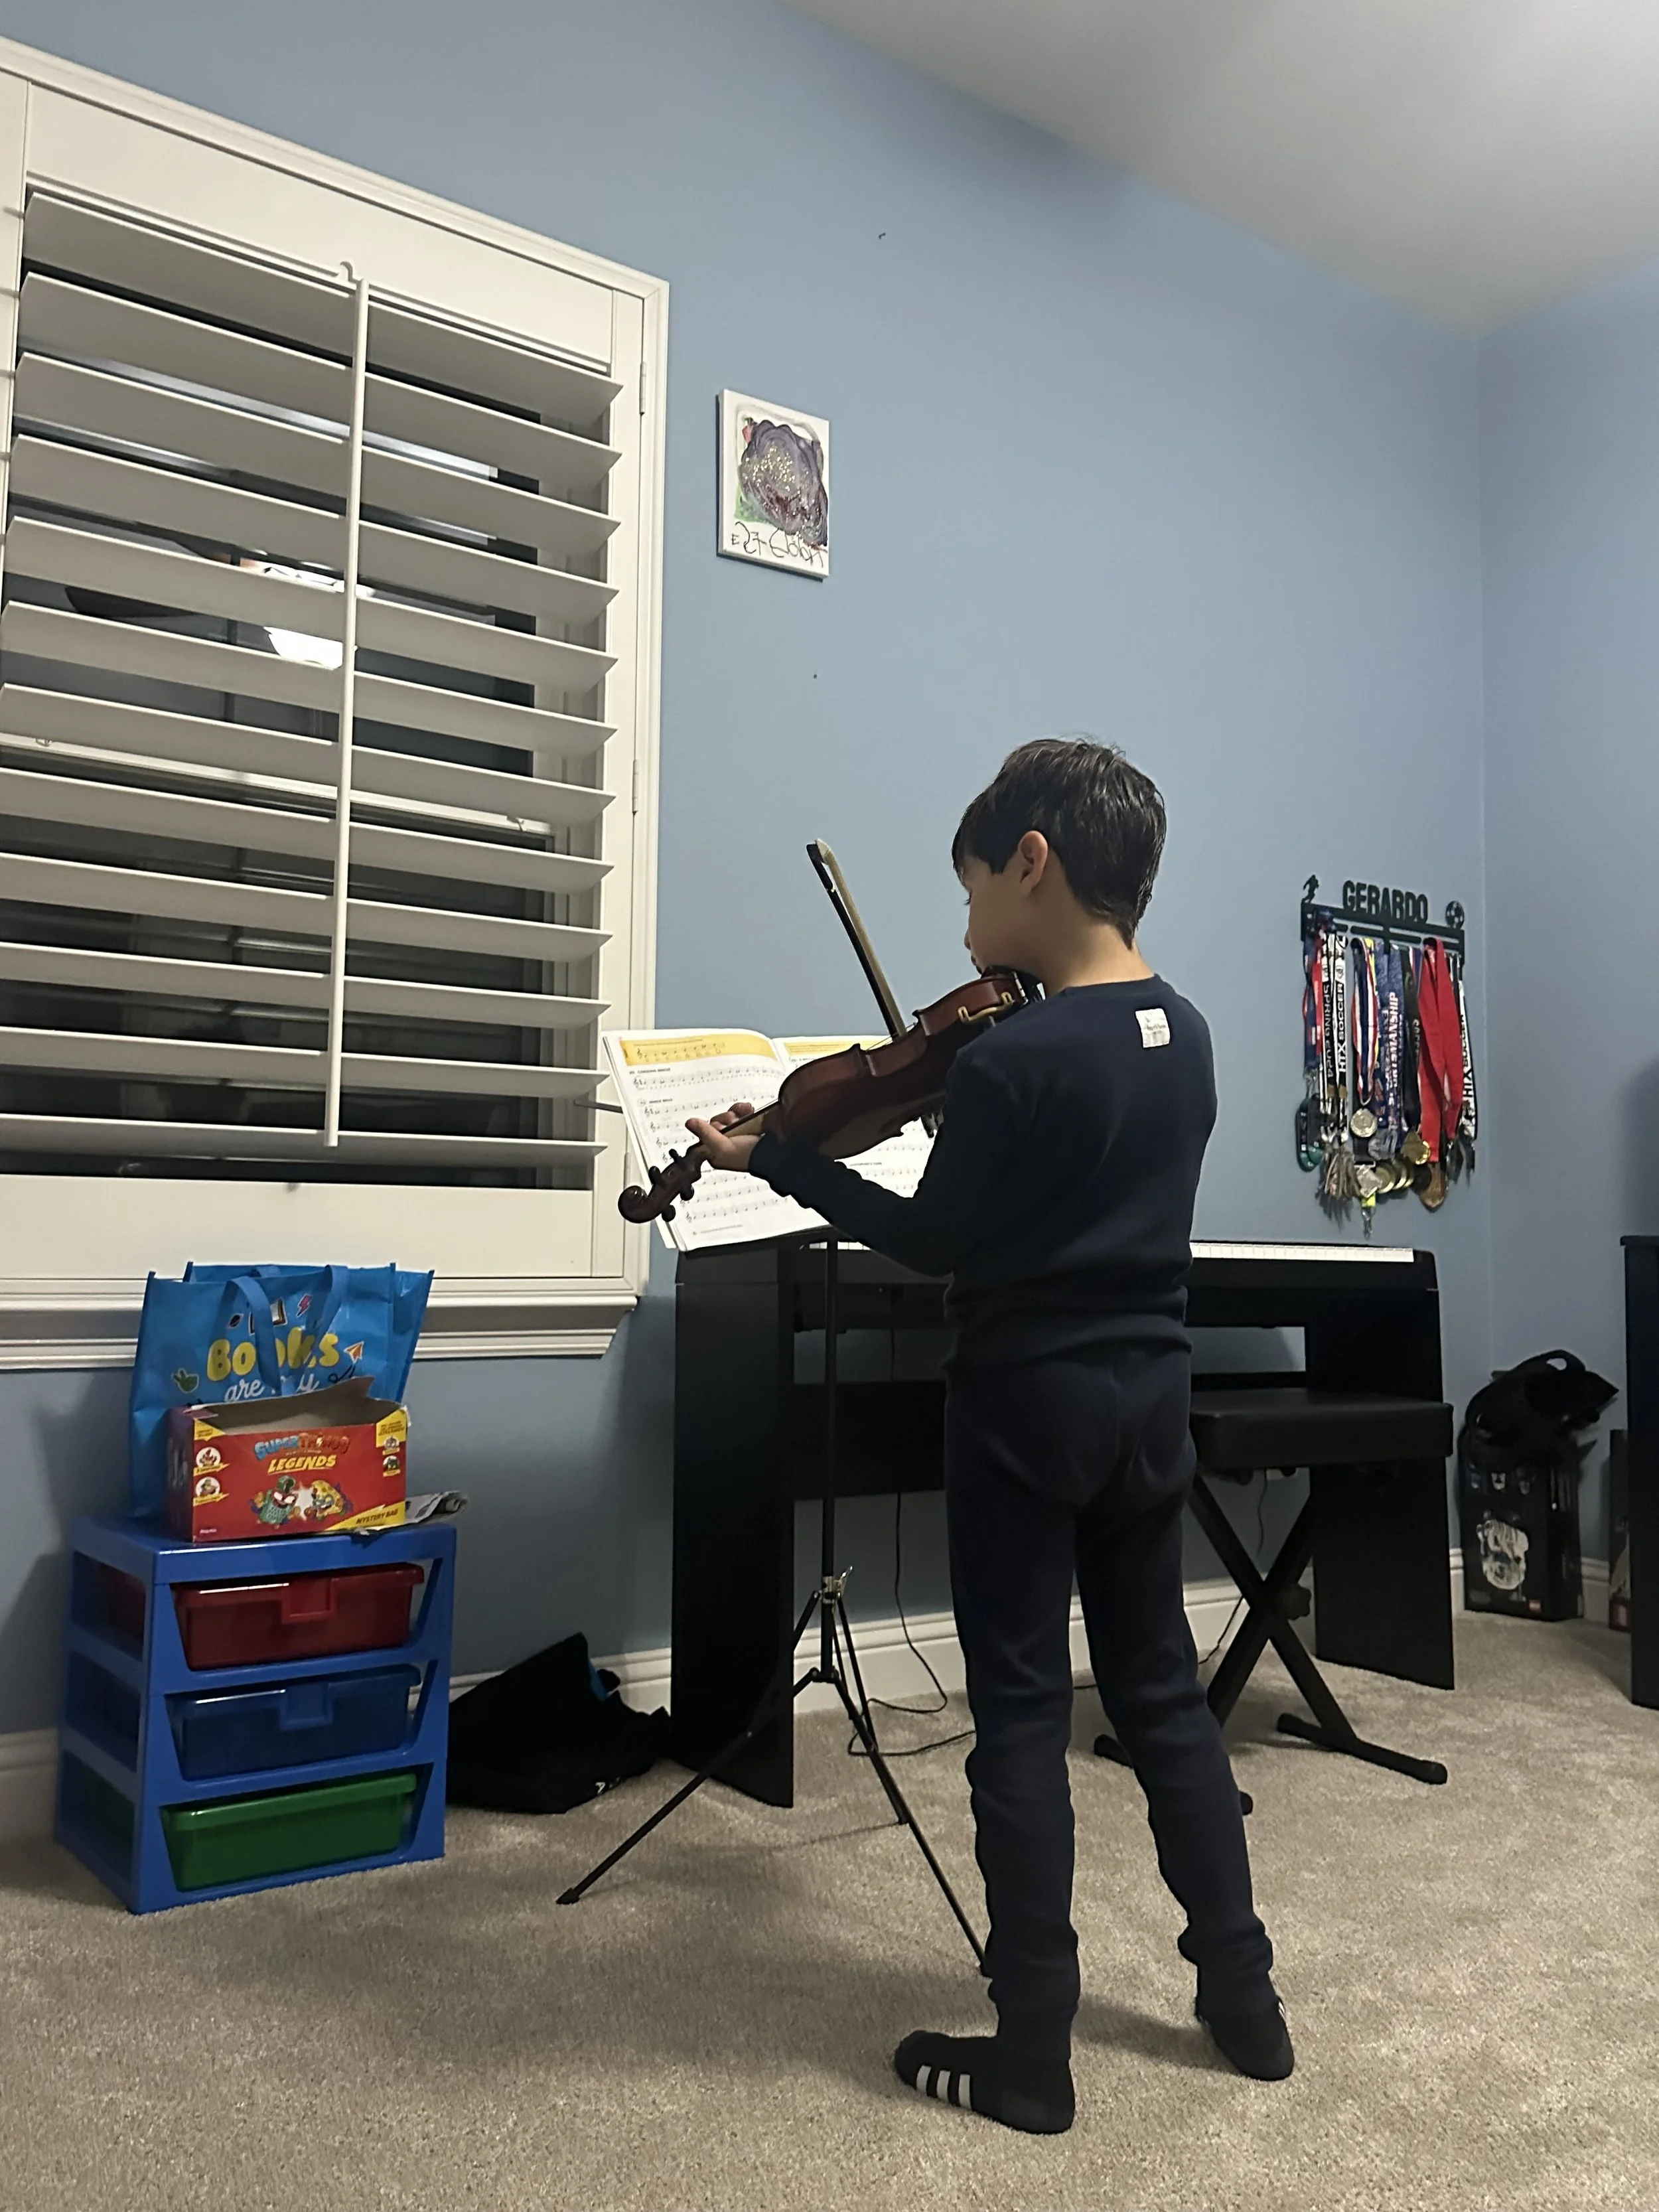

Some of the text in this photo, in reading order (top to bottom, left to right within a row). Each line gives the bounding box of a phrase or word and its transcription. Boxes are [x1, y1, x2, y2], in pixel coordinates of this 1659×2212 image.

[1342, 880, 1428, 924] GERARDO
[1338, 1042, 1346, 1073] HTX
[268, 1455, 337, 1474] LEGENDS
[356, 1509, 398, 1524] MYSTERY BAG
